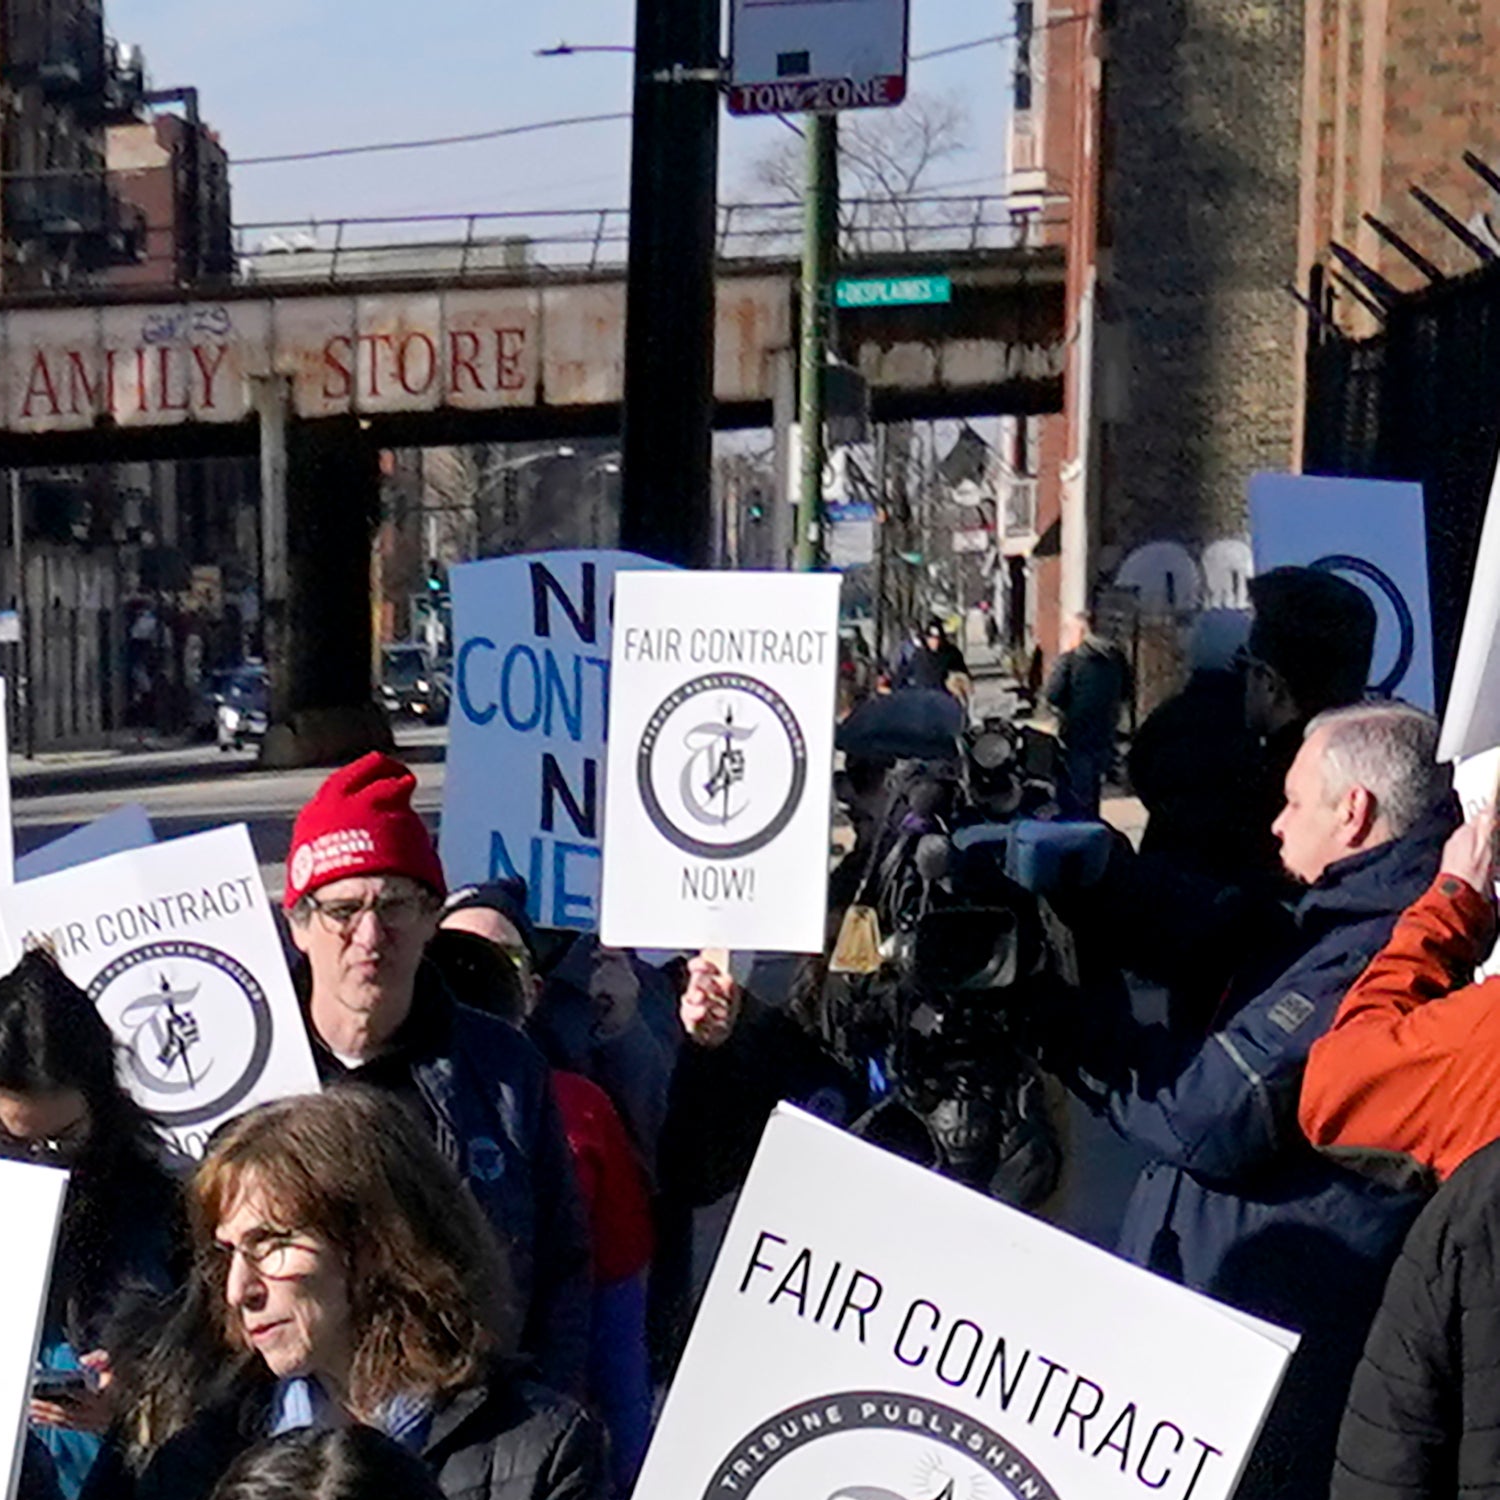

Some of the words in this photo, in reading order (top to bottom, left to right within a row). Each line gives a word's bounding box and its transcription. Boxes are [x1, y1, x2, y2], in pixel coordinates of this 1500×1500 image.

[321, 327, 528, 400] STORE
[530, 562, 615, 644] N
[623, 627, 683, 662] FAIR
[689, 628, 829, 665] CONTRACT
[95, 876, 256, 948] CONTRACT
[681, 867, 756, 902] NOW!
[739, 1229, 884, 1346] FAIR
[719, 1404, 844, 1493] TRIBUNE
